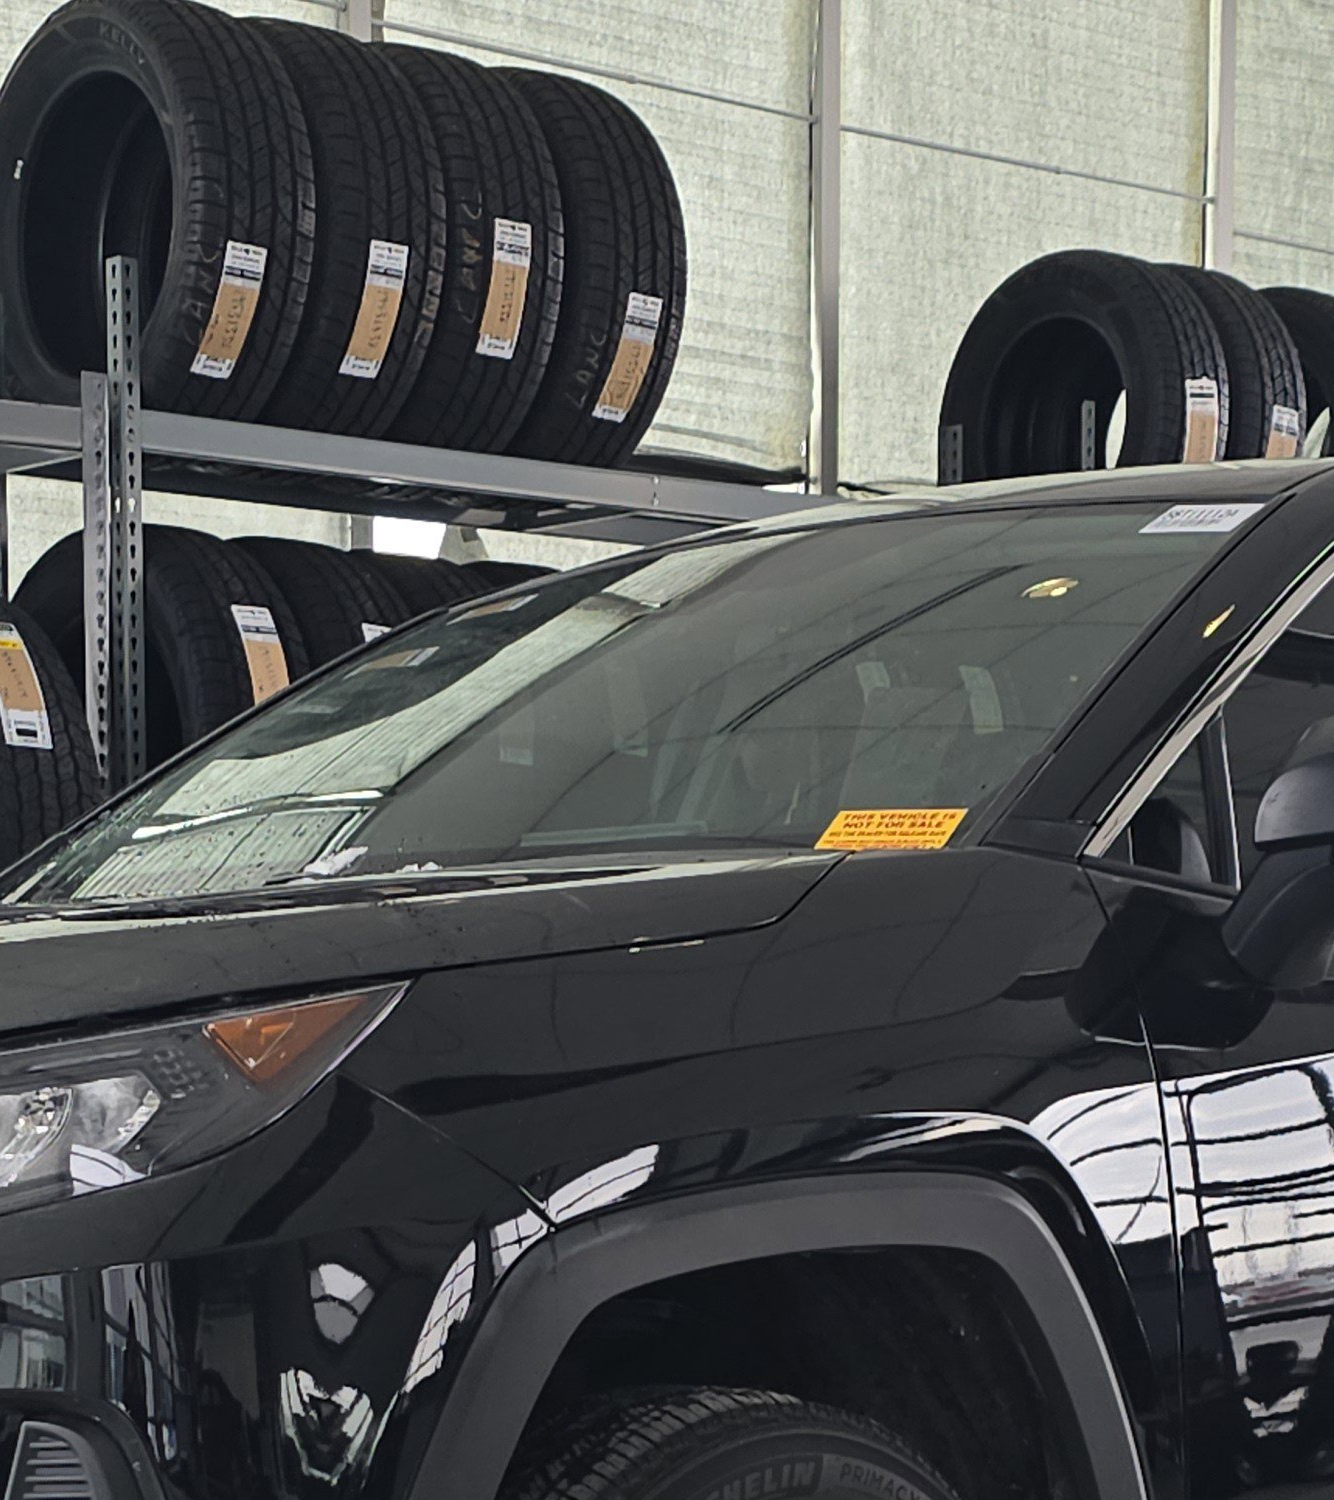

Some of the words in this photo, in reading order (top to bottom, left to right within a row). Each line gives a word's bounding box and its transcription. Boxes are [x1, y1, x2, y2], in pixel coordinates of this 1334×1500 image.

[843, 813, 876, 821] THIS
[880, 812, 940, 820] VEHICLE
[943, 812, 957, 820] IS
[843, 821, 873, 829] NOT
[876, 821, 906, 829] FOR
[907, 820, 944, 828] SALE
